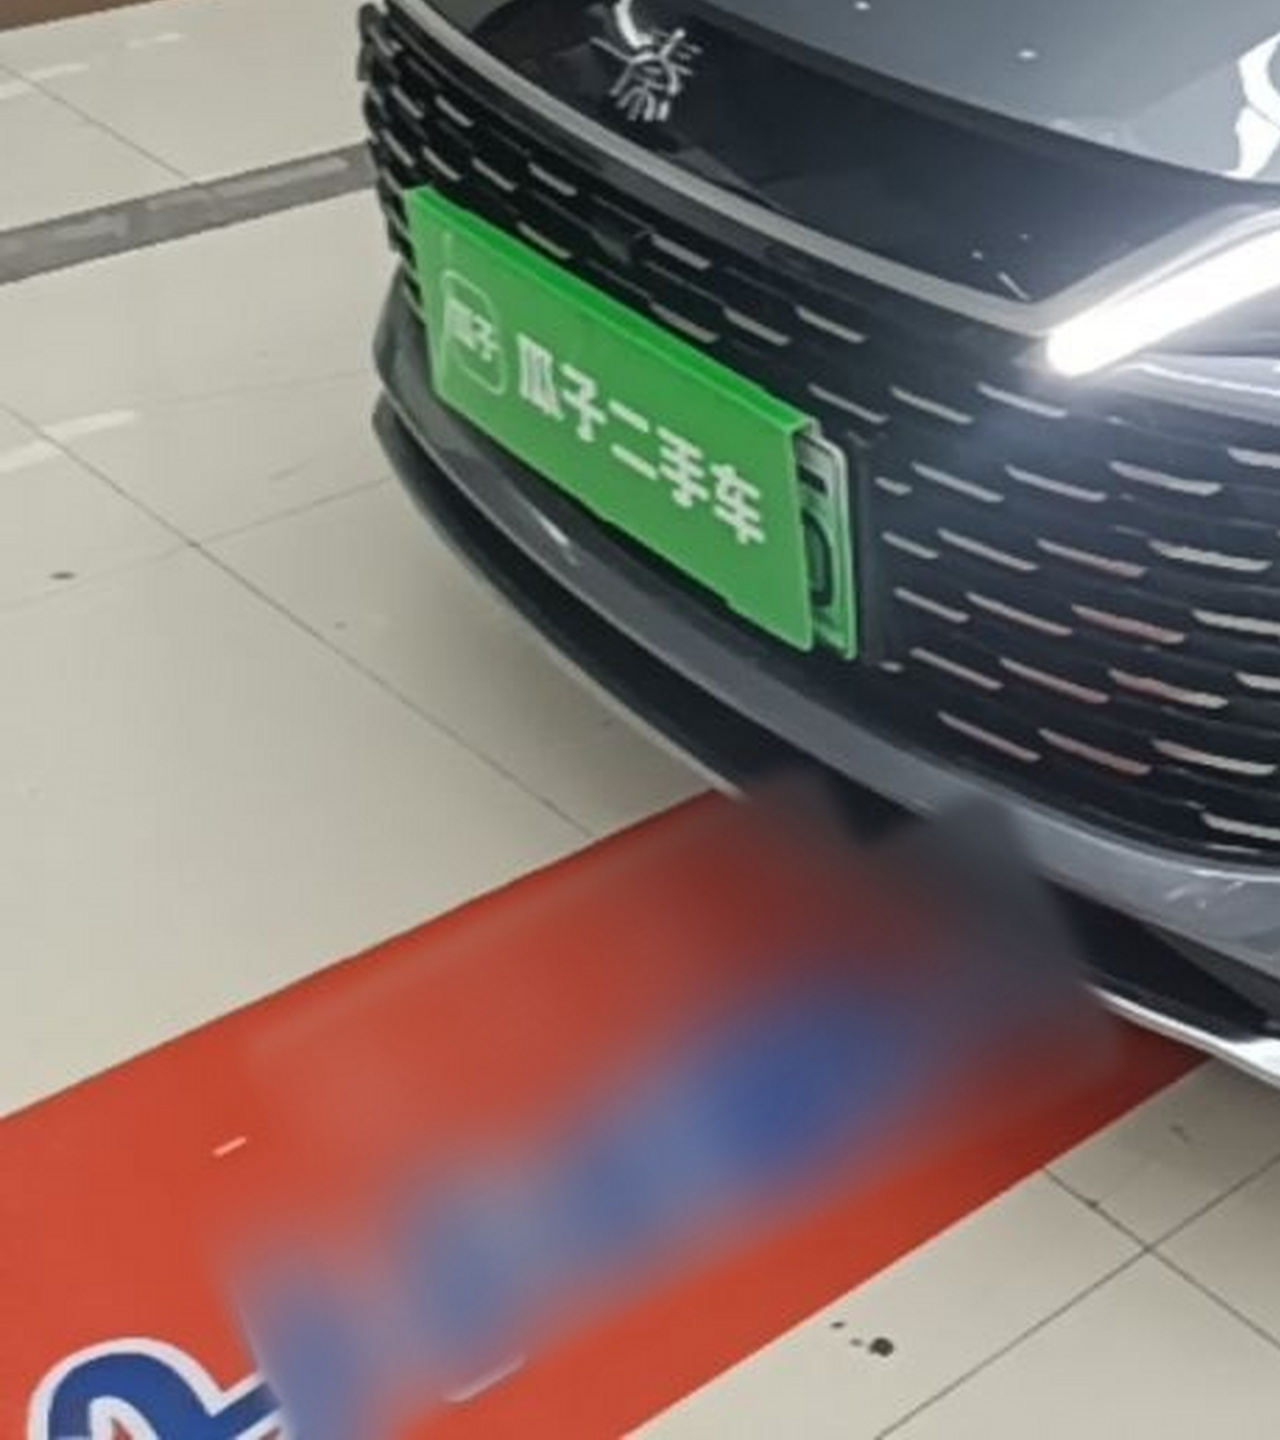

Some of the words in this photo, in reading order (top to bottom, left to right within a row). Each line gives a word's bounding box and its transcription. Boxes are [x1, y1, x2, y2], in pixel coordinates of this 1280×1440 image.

[515, 331, 767, 545] 瓜子二手车
